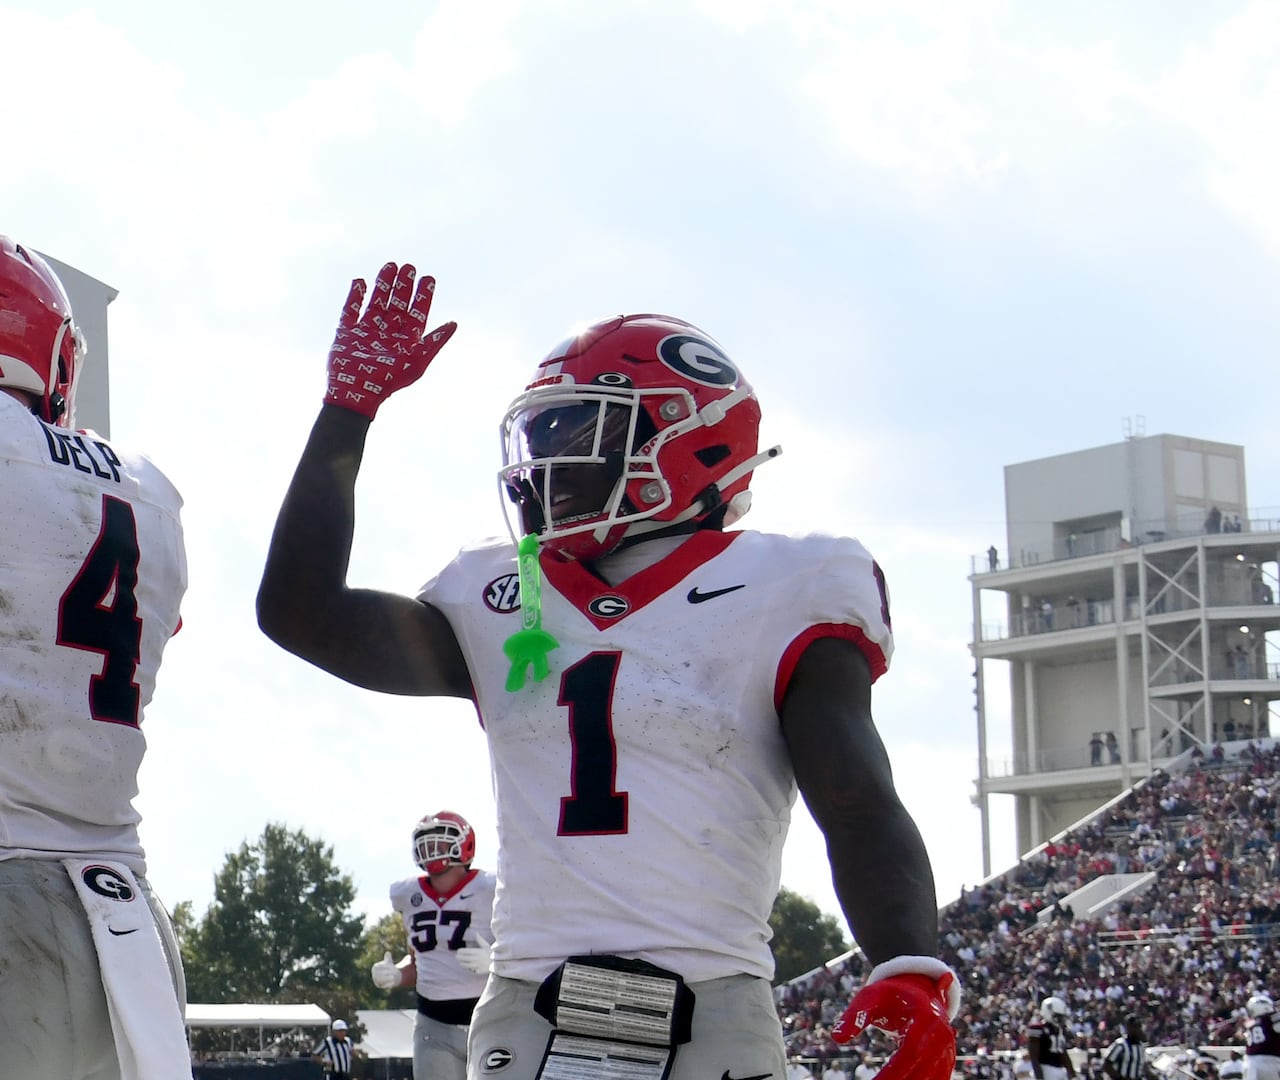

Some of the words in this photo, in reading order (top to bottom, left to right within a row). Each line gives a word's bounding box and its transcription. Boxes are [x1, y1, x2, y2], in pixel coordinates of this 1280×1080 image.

[668, 338, 734, 382] G
[42, 422, 124, 484] DELP
[55, 493, 143, 730] 4
[487, 574, 521, 611] SE
[592, 597, 628, 616] G
[556, 649, 629, 837] 1
[88, 869, 133, 901] G
[410, 910, 472, 953] 57
[483, 1050, 513, 1070] G
